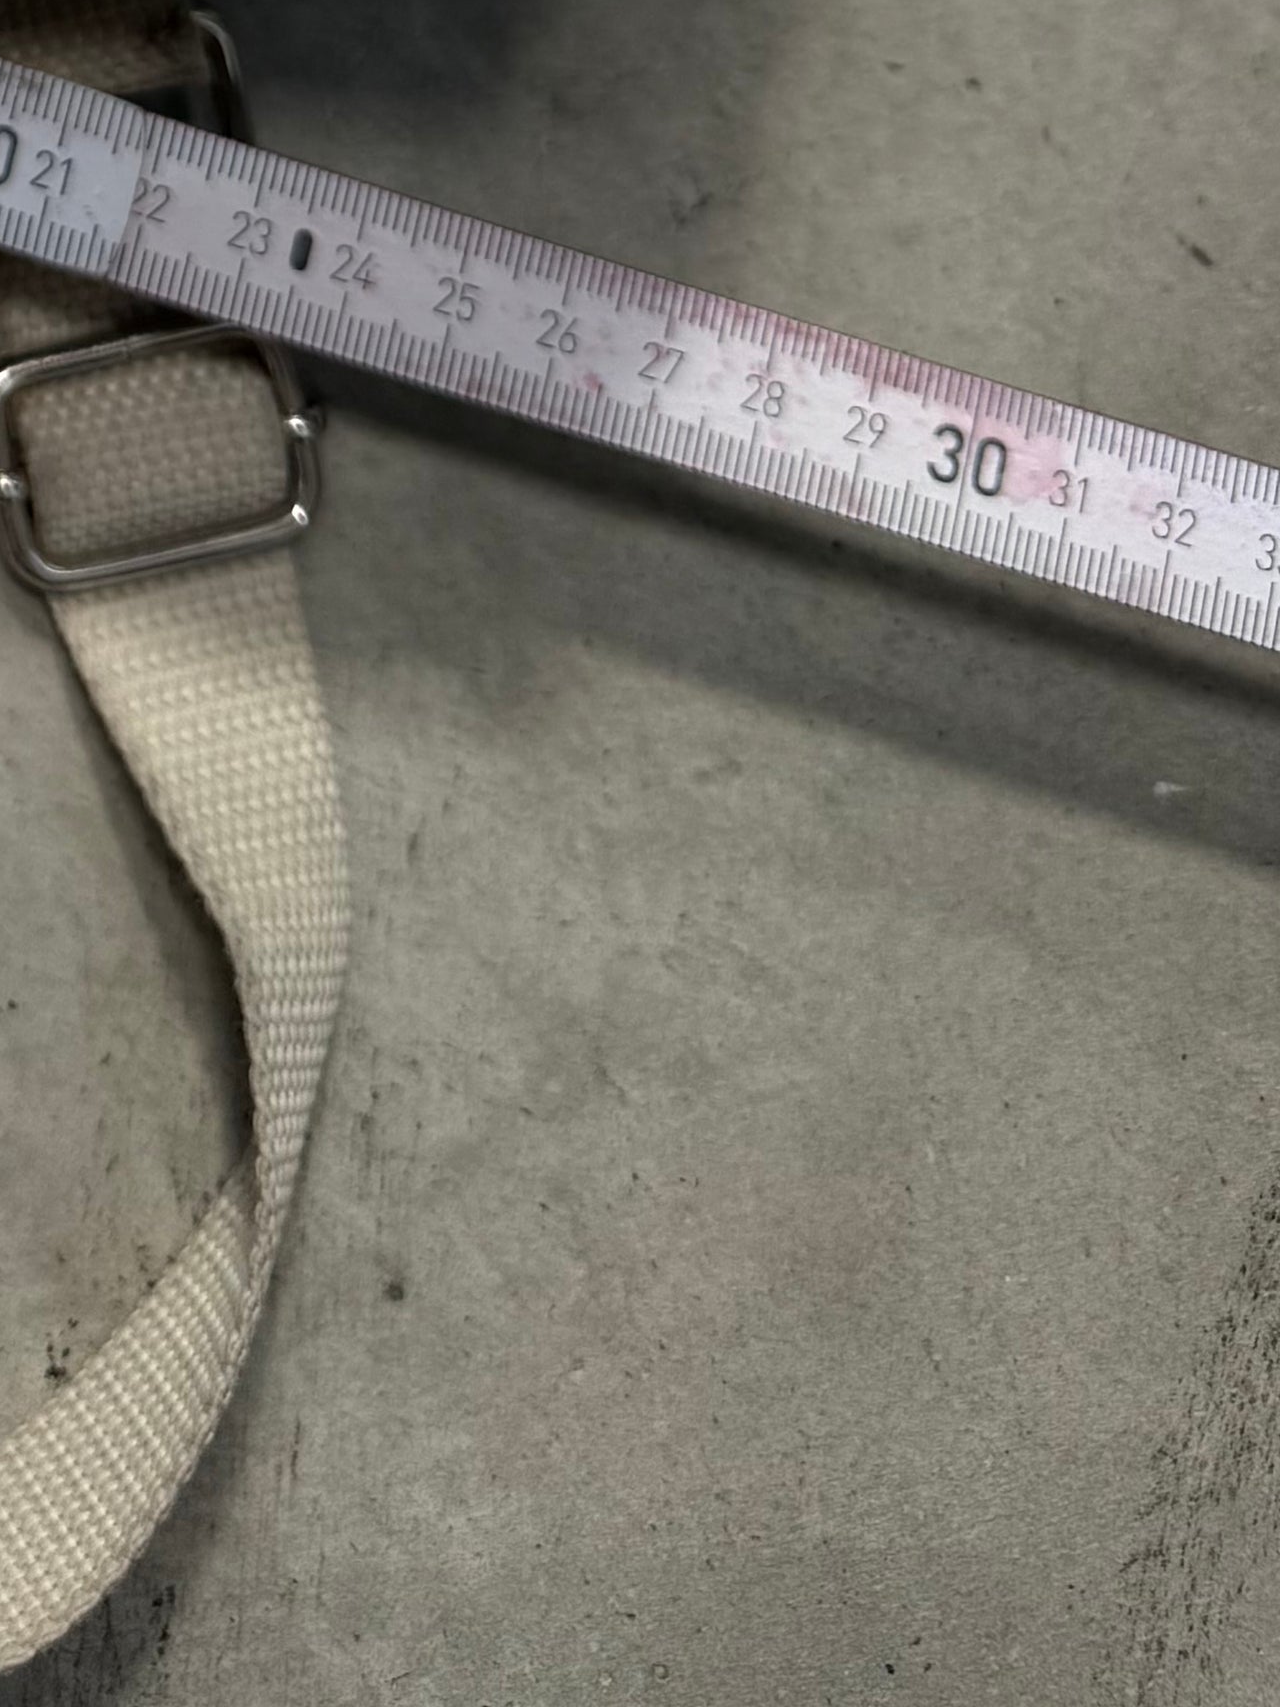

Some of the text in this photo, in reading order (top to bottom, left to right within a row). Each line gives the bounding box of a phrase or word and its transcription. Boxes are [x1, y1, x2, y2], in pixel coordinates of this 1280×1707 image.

[30, 148, 74, 196] 21
[131, 177, 172, 224] 22
[226, 209, 273, 256] 23
[330, 243, 377, 290] 24
[433, 276, 481, 322] 25
[536, 309, 579, 355] 26
[640, 340, 685, 385] 27
[740, 372, 787, 419] 28
[842, 404, 889, 449] 29
[926, 422, 1008, 498] 30
[1047, 469, 1091, 514] 31
[1151, 500, 1198, 547] 32
[1254, 532, 1280, 573] 3
